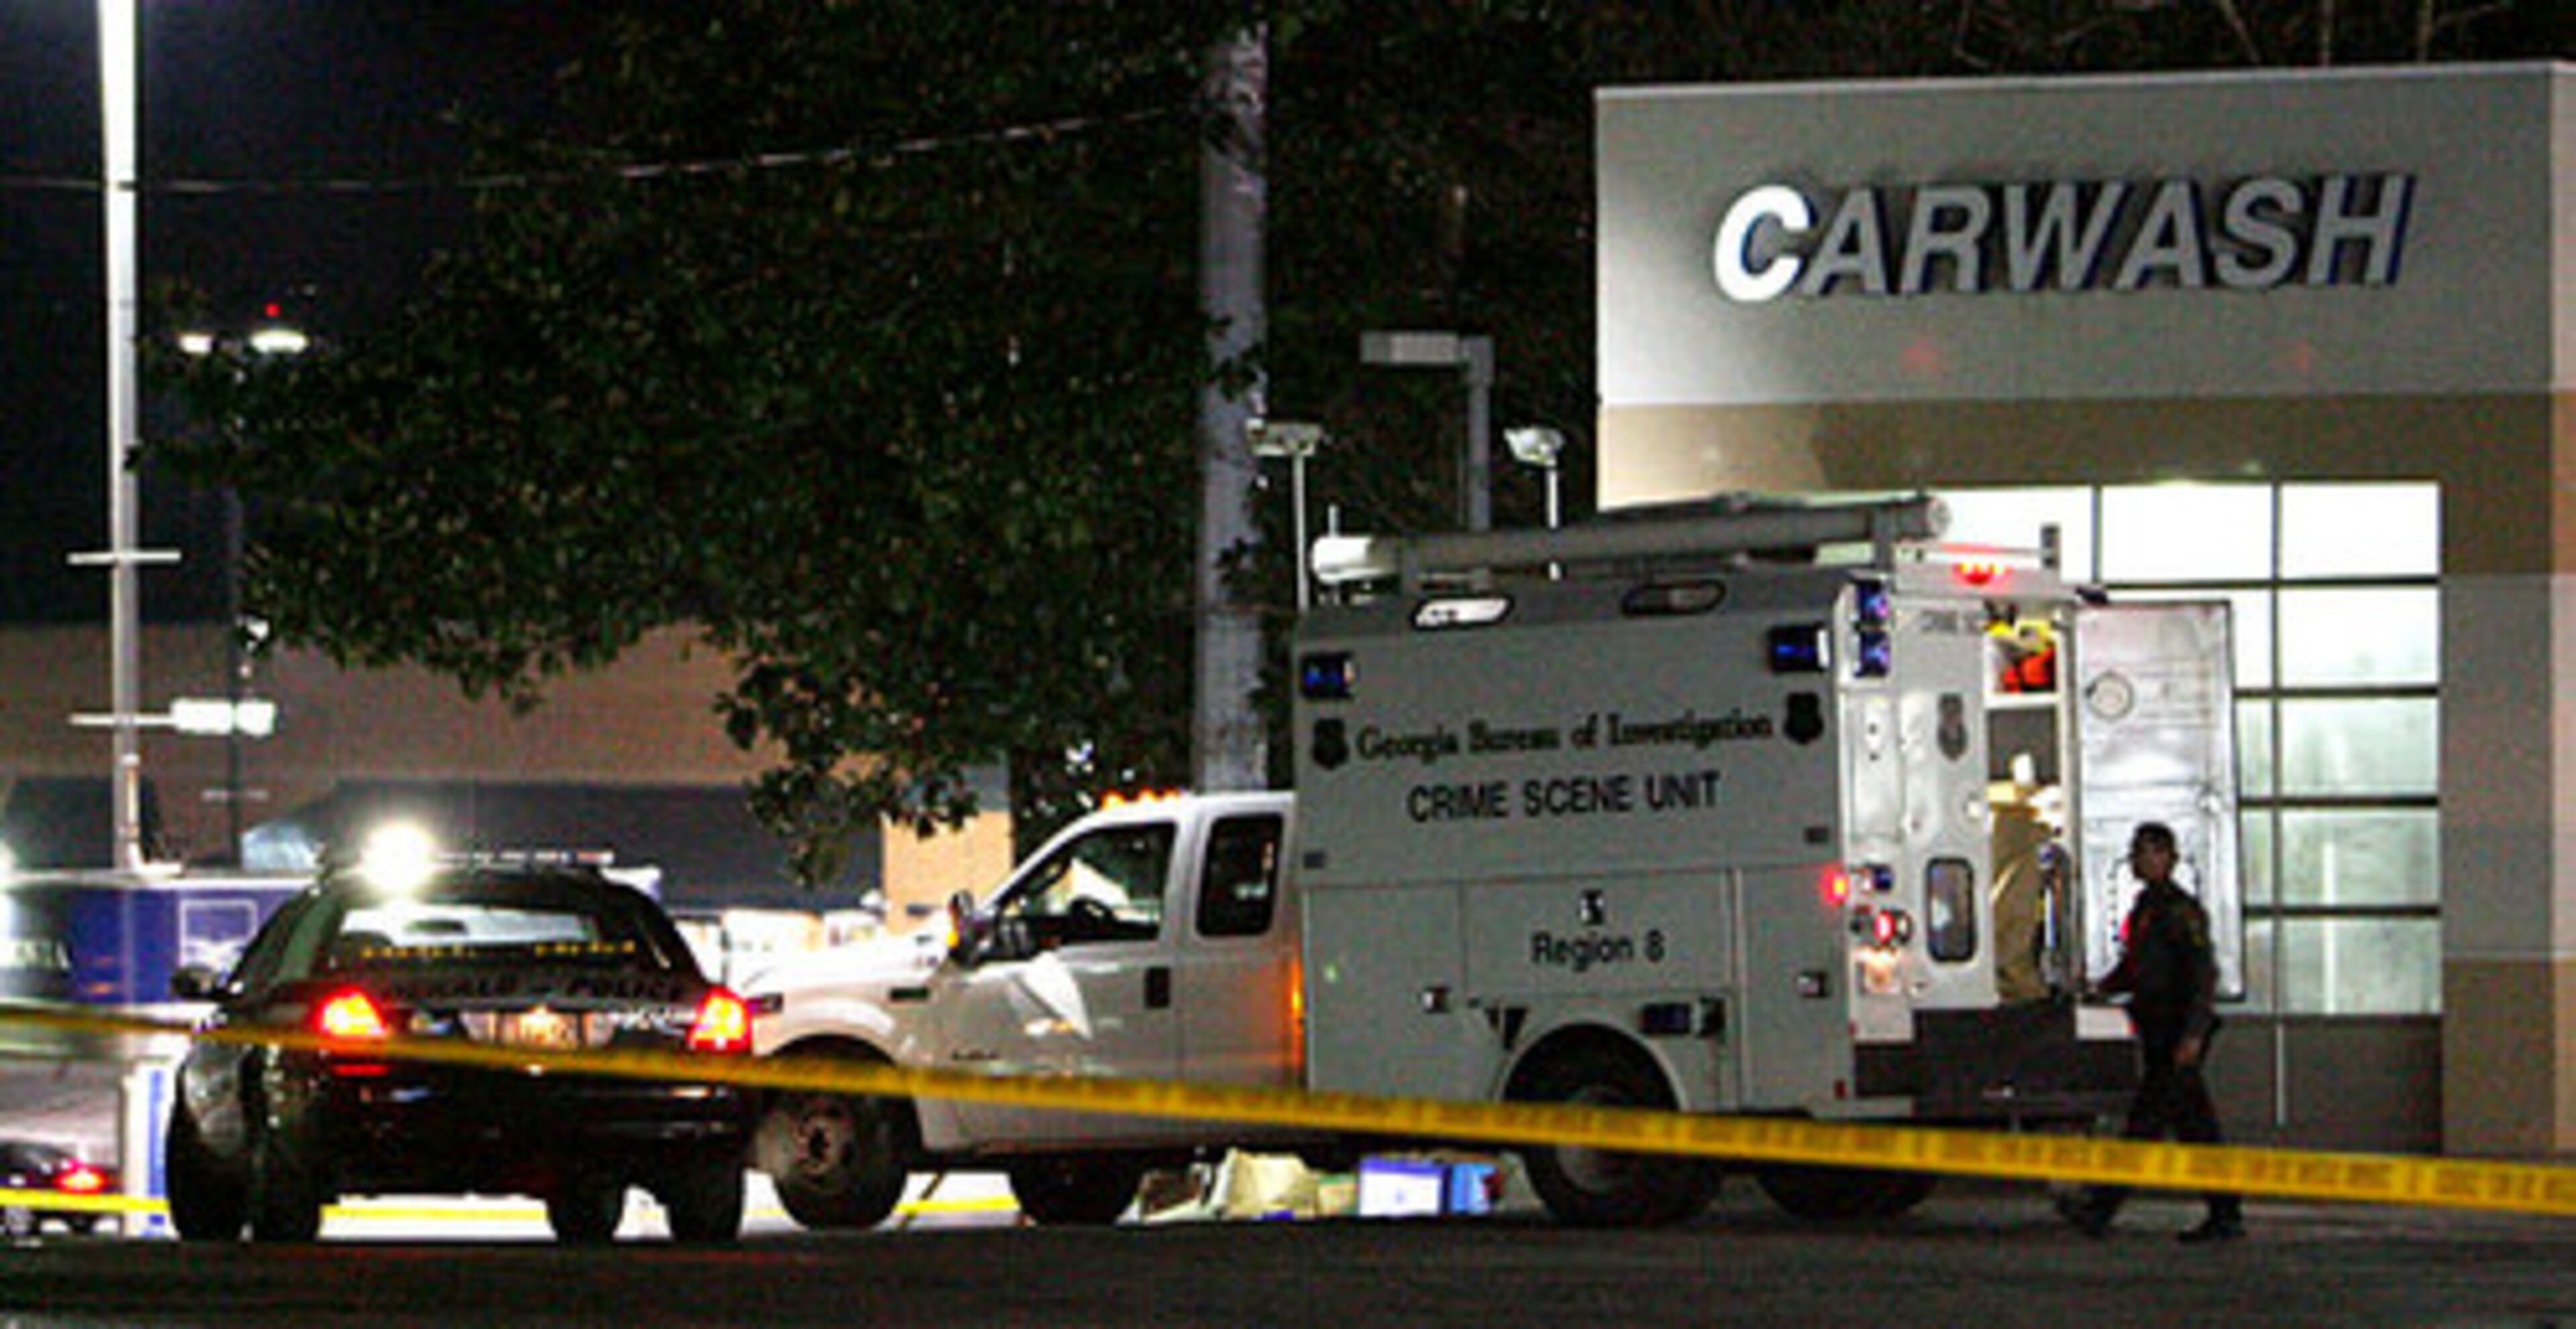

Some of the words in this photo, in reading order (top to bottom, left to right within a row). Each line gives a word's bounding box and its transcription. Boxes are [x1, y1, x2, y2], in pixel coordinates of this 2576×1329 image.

[1712, 173, 2415, 303] CARWASH
[1357, 723, 1459, 765] Georgia
[1468, 719, 1560, 753] Bureau
[1570, 712, 1599, 750] of
[1607, 708, 1773, 751] Investigation
[1407, 781, 1509, 823] CRIME
[1523, 774, 1633, 818] SCENE
[1645, 769, 1720, 811] UNIT
[1532, 930, 1635, 973] Region
[1645, 928, 1666, 964] 8
